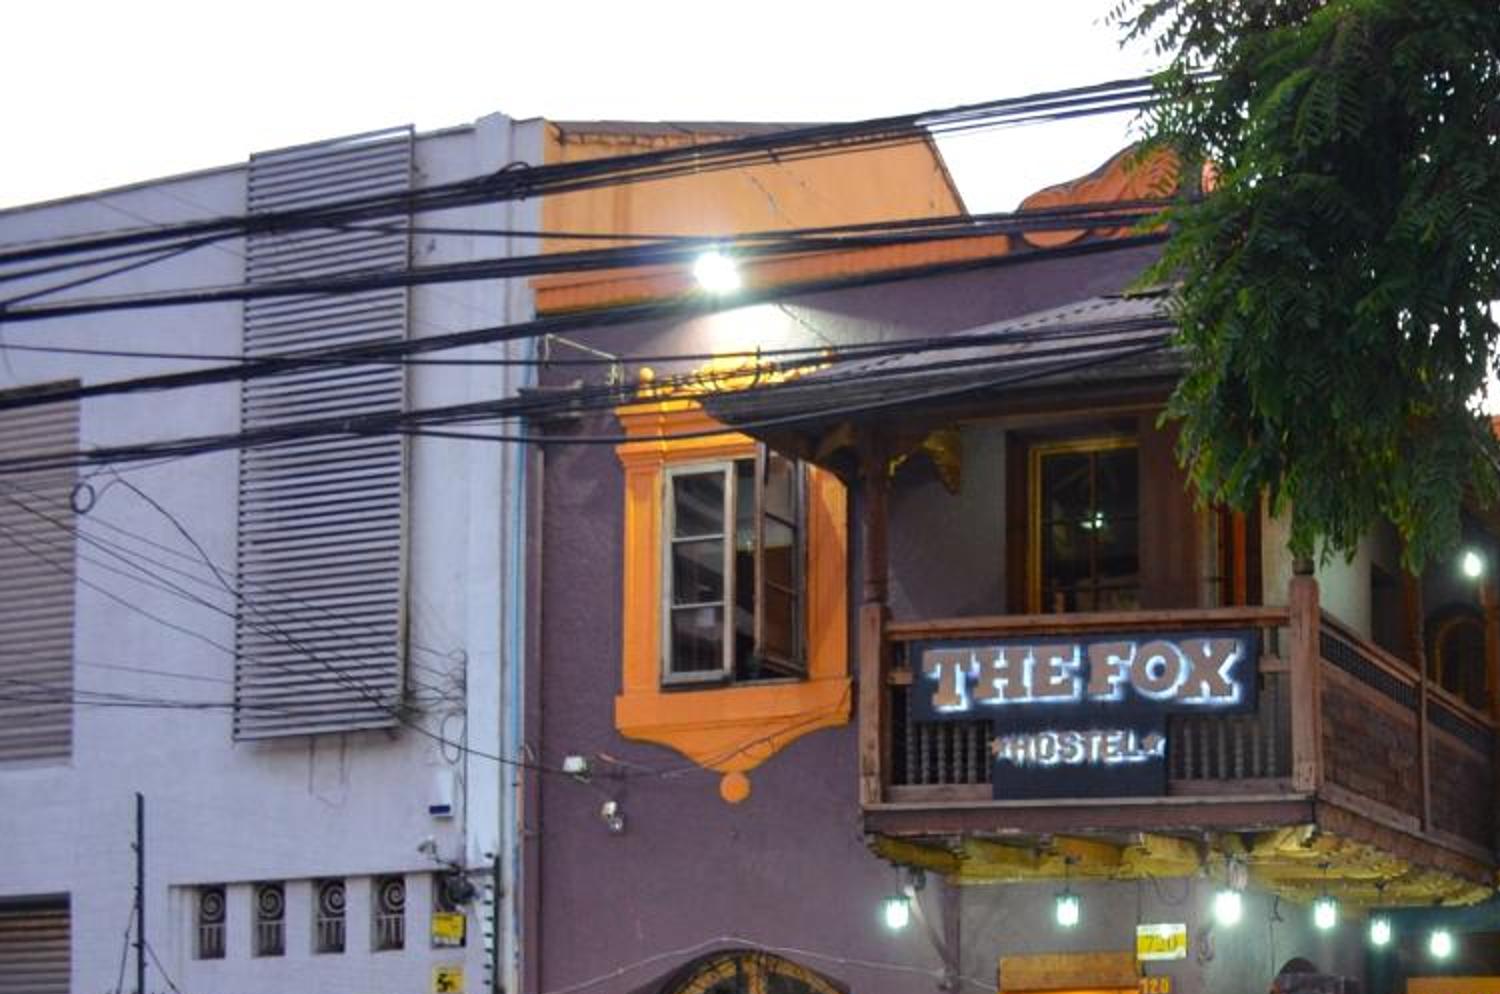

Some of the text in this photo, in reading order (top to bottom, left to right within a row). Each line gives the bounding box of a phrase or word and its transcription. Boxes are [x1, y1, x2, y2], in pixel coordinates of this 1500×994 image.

[921, 638, 1242, 712] THE FOX
[1010, 731, 1148, 766] HOSTEL
